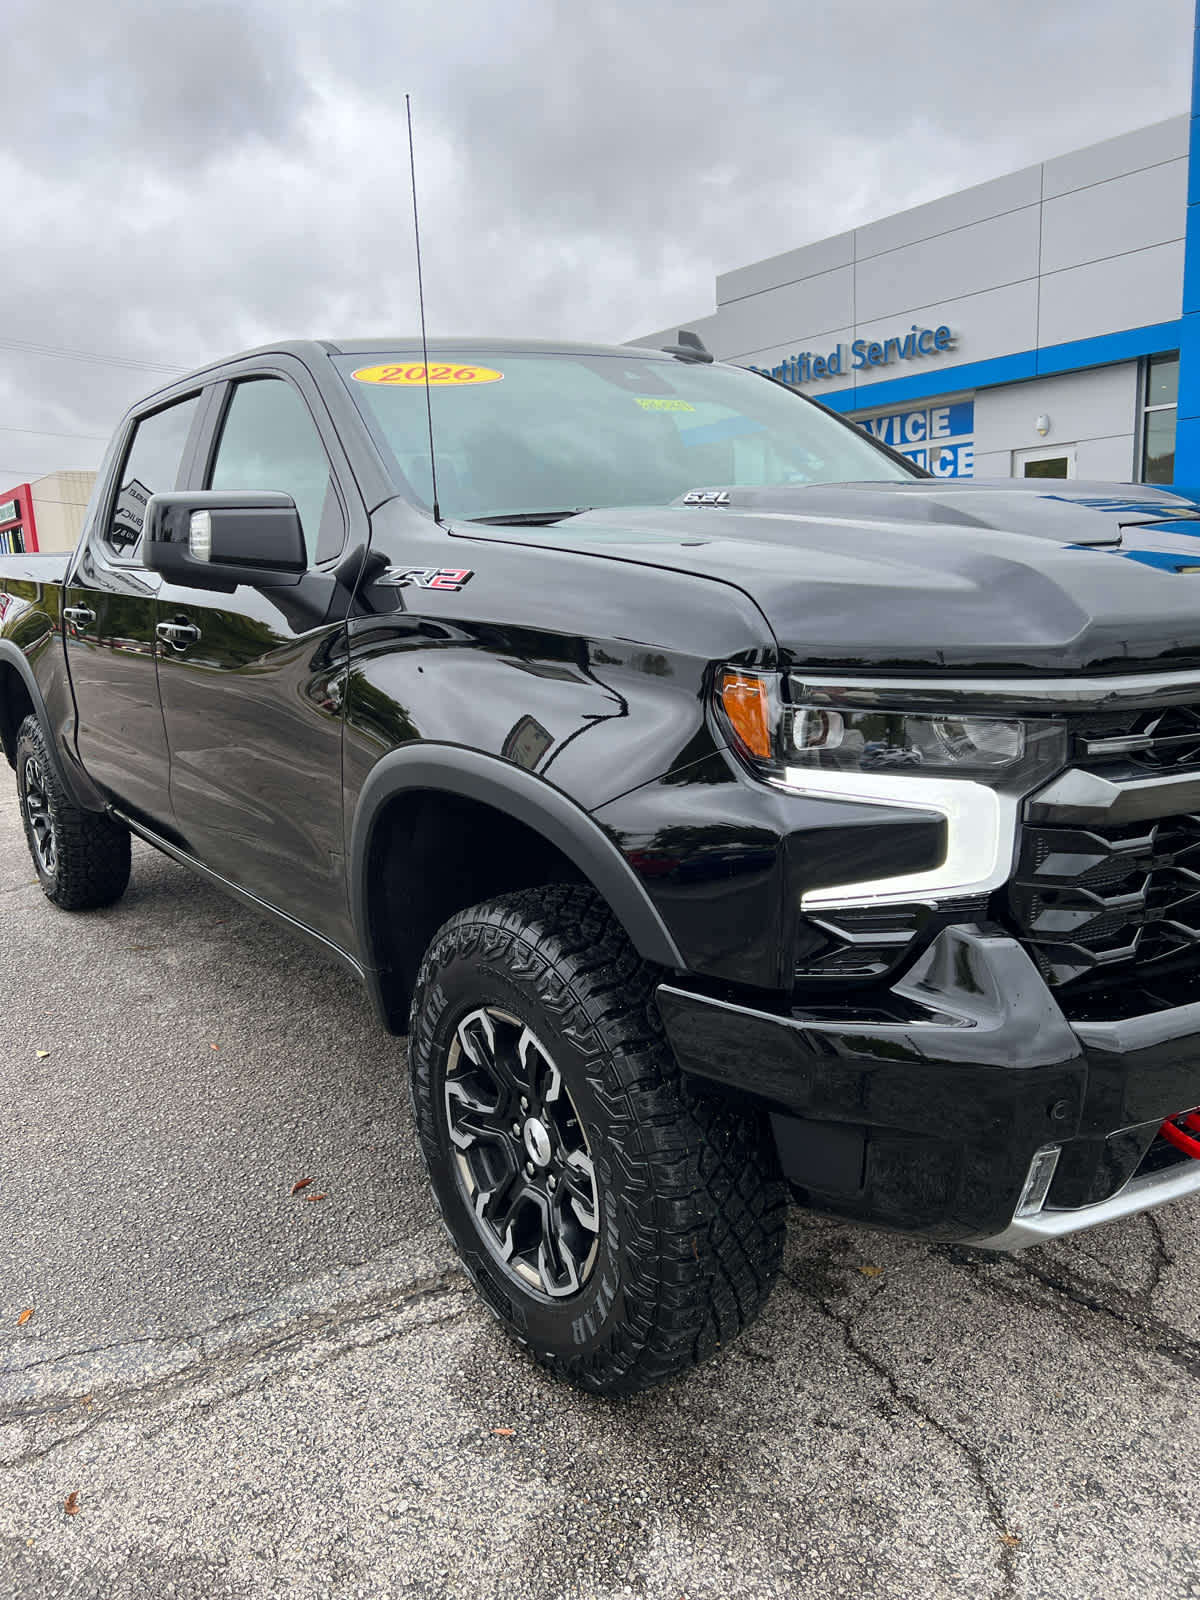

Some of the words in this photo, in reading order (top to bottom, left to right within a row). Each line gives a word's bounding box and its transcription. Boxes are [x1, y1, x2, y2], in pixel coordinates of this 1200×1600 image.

[749, 343, 842, 385] rtified
[851, 325, 951, 369] Service
[378, 366, 478, 382] 2026
[855, 408, 951, 444] VICE
[373, 566, 472, 591] ZR2
